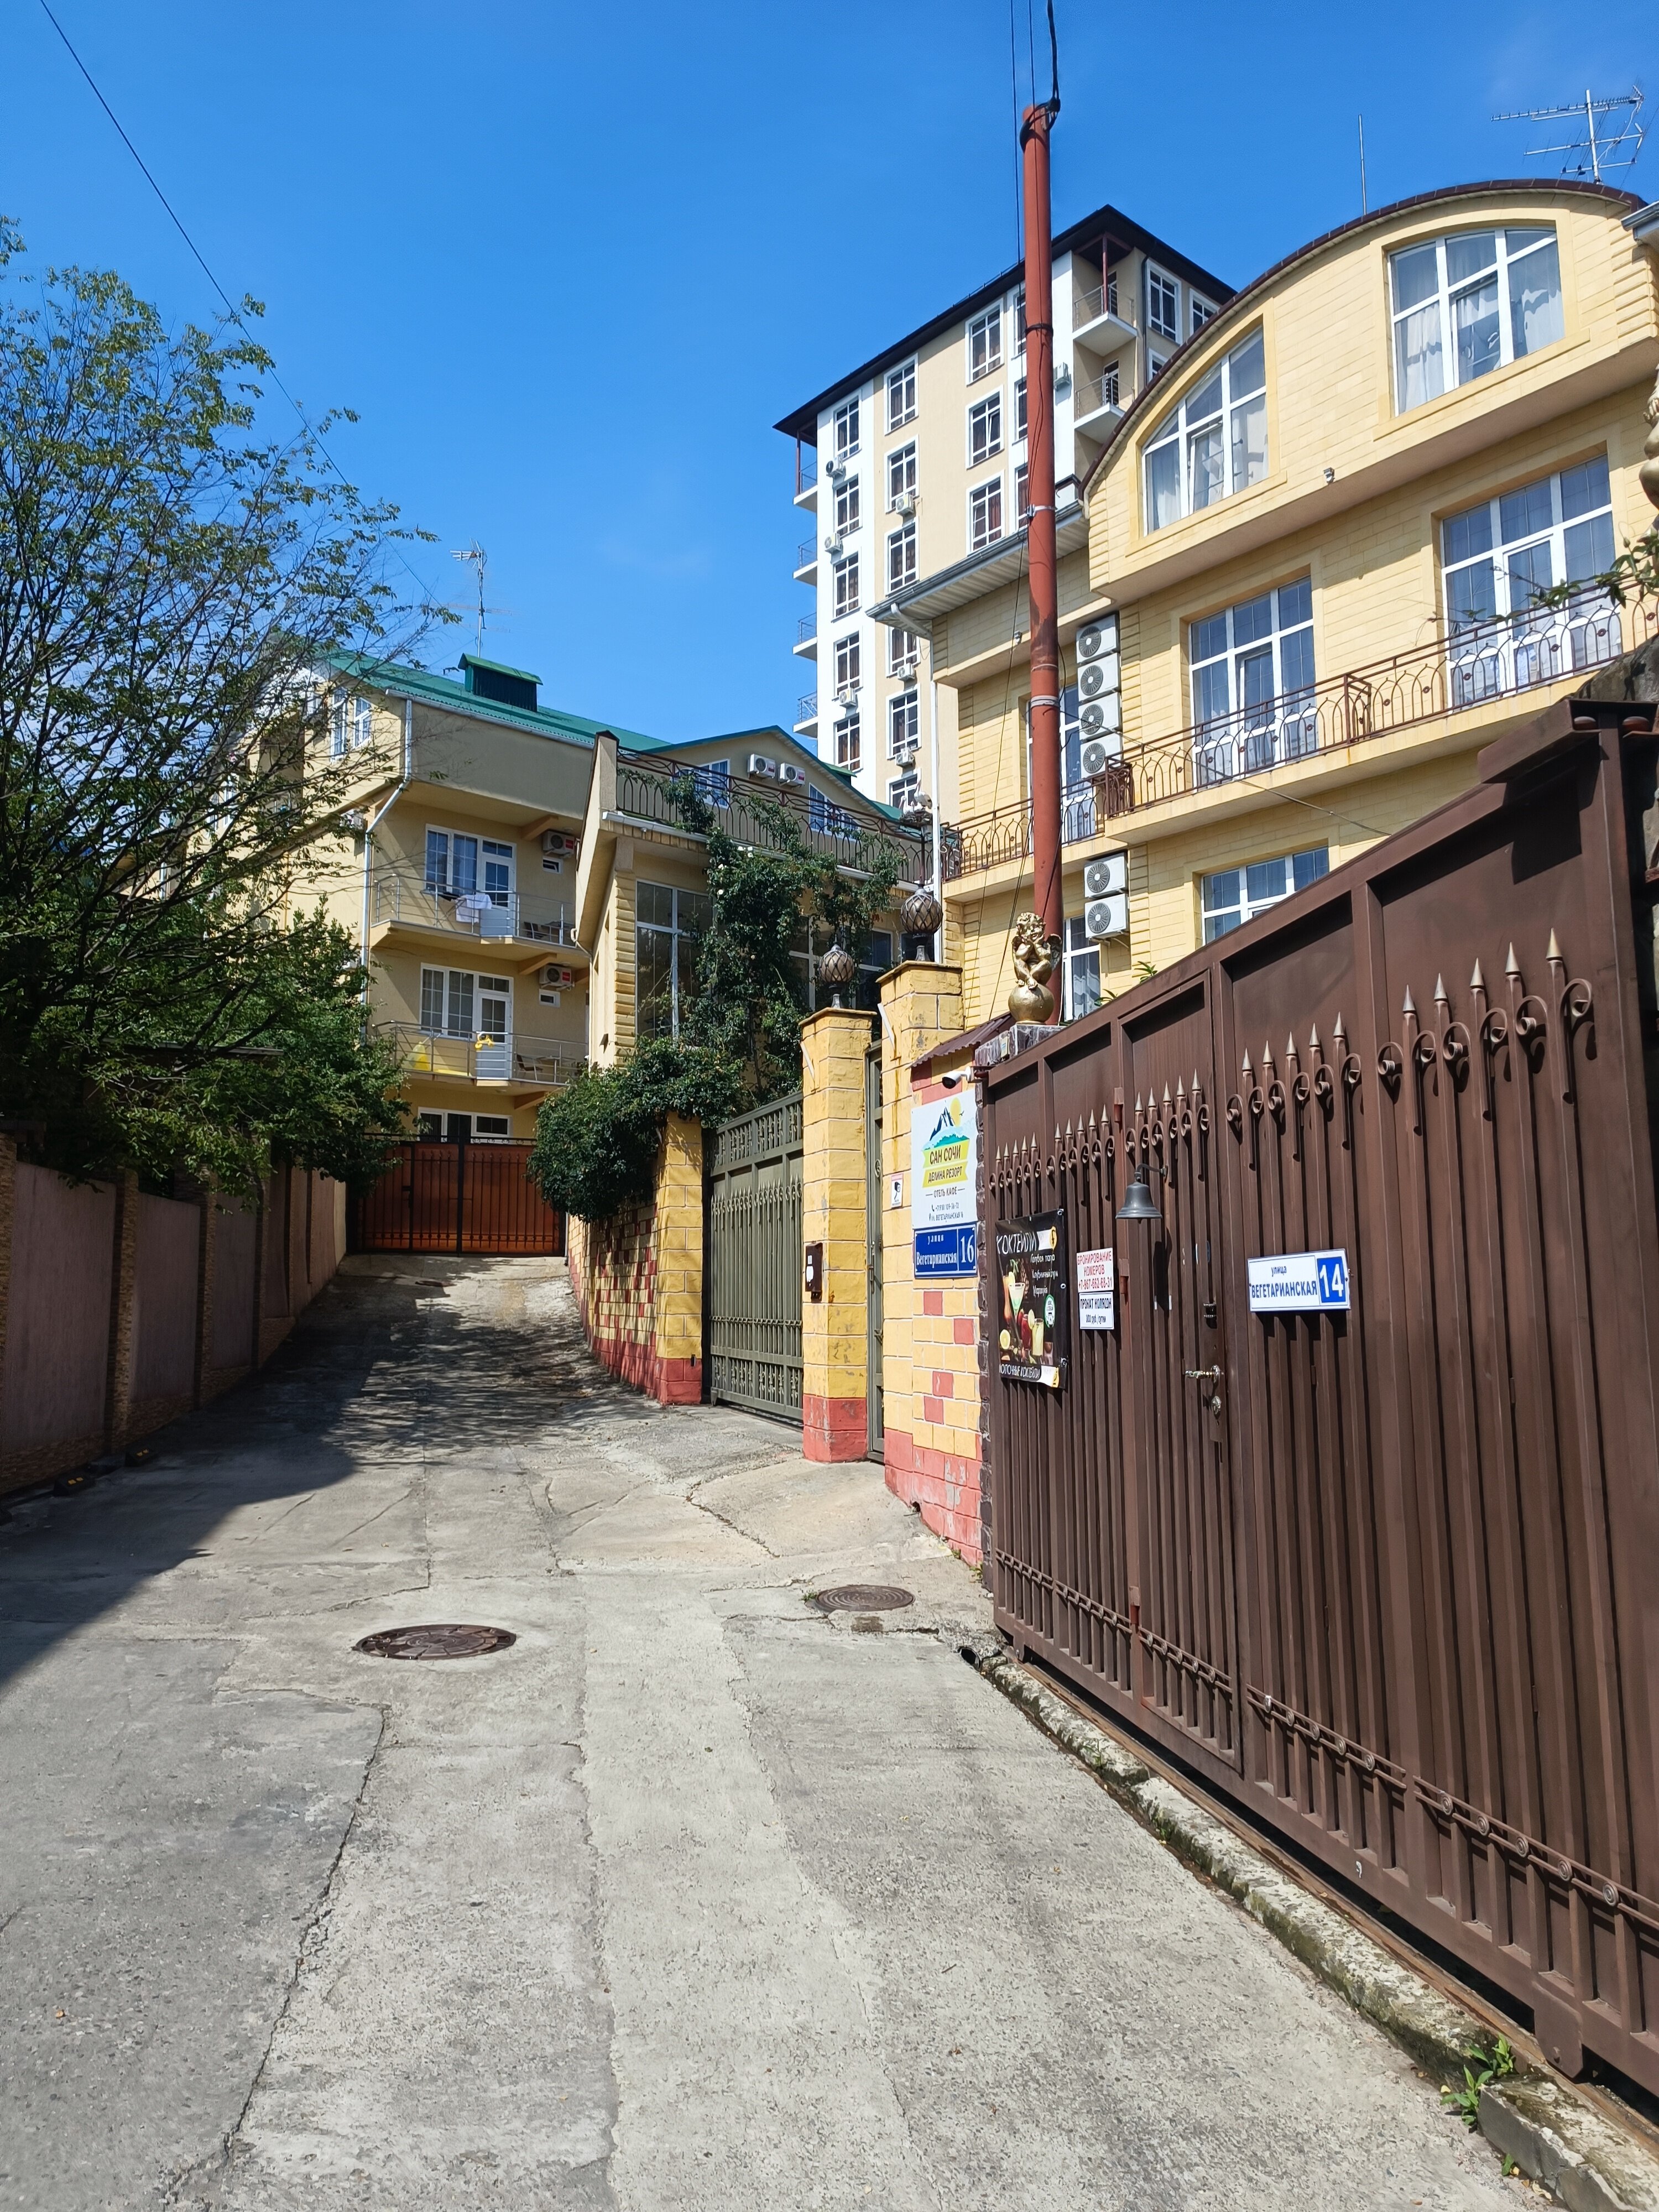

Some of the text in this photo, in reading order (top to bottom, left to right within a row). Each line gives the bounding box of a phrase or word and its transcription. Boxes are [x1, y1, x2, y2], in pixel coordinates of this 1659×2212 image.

[930, 1144, 961, 1165] САН СОЧИ
[928, 1166, 963, 1184] ДЕЛИНА РЕЗОРТ
[933, 1186, 957, 1198] ОТЕЛЬ КАФЕ
[927, 1234, 945, 1245] улица
[960, 1234, 974, 1263] 16
[996, 1230, 1037, 1255] КОКТЕЙЛИ
[916, 1251, 957, 1269] Вегетарианская
[1077, 1251, 1112, 1265] БРОНИРОВАНИЕ
[1083, 1264, 1105, 1277] НОМЕРОВ
[1271, 1266, 1287, 1277] улица
[1251, 1280, 1318, 1298] ВЕГЕТАРИАНСКАЯ
[1319, 1264, 1344, 1298] 14
[1080, 1297, 1112, 1310] ПРОКАТ КОЛЯСОК
